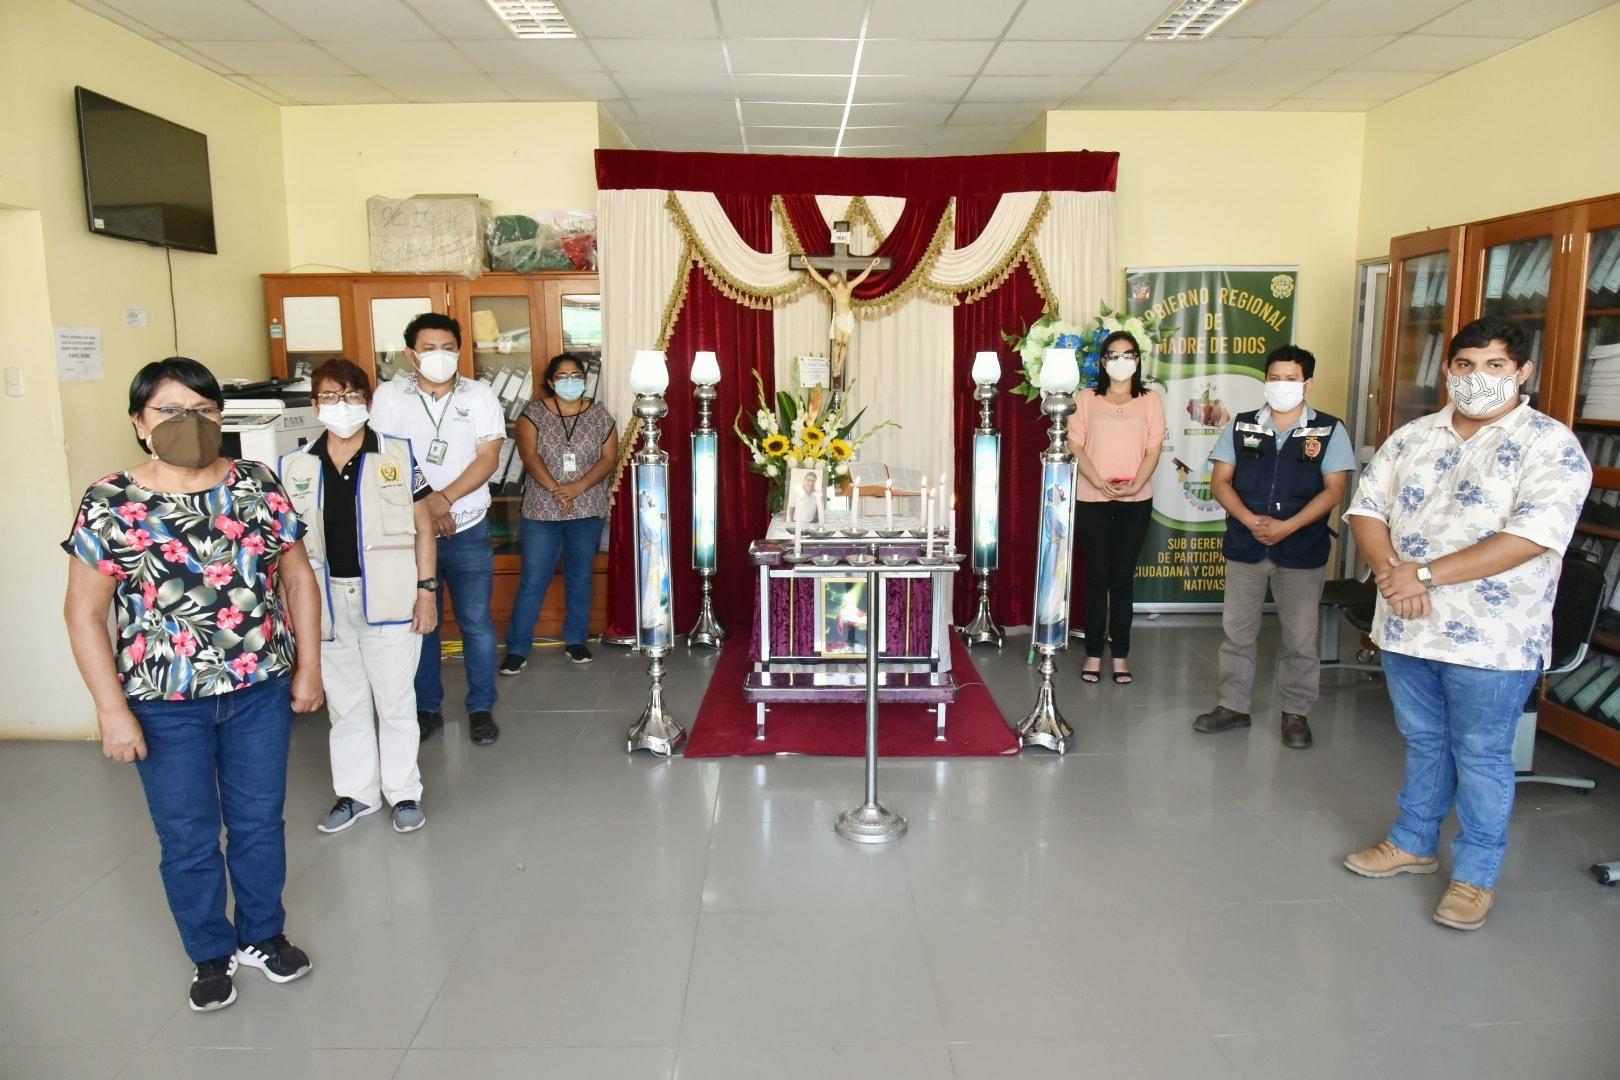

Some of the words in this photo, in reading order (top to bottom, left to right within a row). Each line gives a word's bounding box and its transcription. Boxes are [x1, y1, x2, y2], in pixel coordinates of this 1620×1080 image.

[1220, 287, 1286, 332] REGIONAL
[1204, 313, 1222, 331] DE
[1156, 336, 1205, 354] MADRE
[1210, 336, 1228, 354] DE
[1233, 336, 1266, 354] DIOS
[1168, 538, 1187, 550] SUB
[1158, 552, 1171, 564] DE
[1174, 552, 1225, 563] PARTICIPA
[1193, 566, 1199, 576] Y
[1184, 580, 1225, 590] NATIVAS
